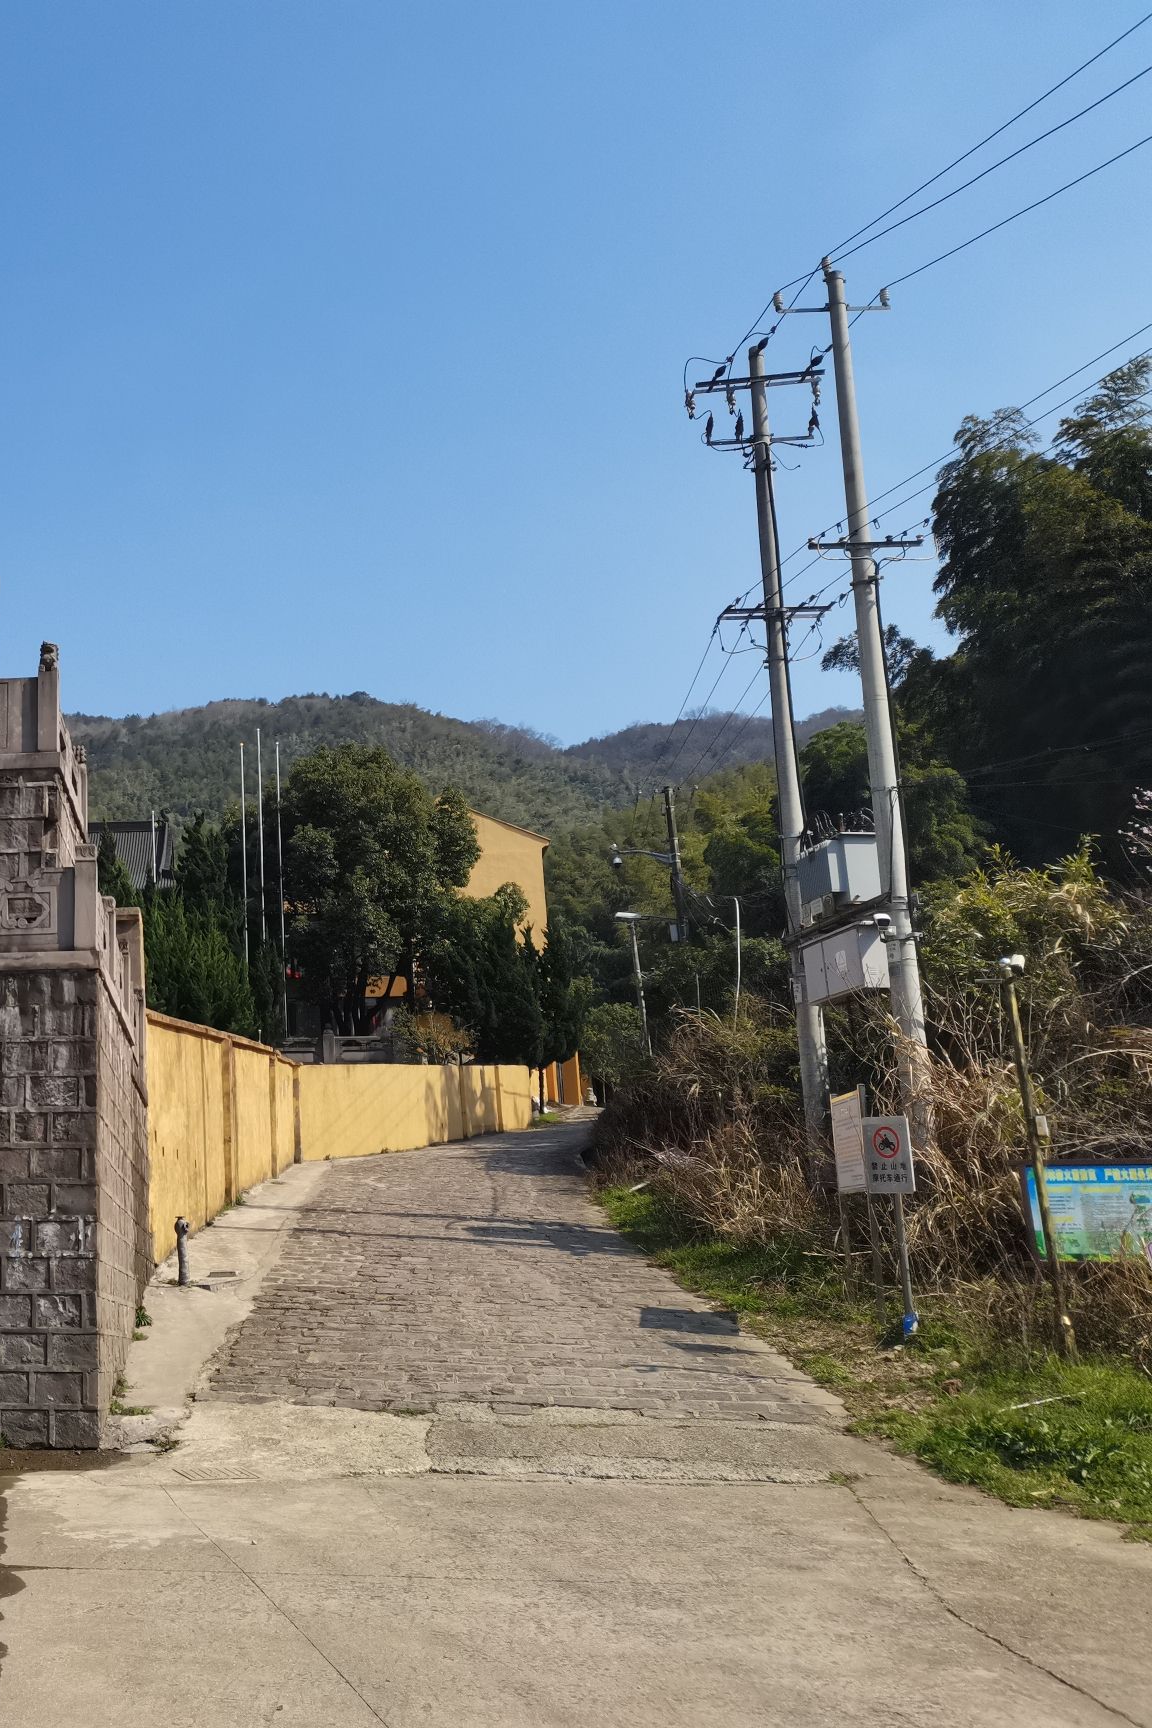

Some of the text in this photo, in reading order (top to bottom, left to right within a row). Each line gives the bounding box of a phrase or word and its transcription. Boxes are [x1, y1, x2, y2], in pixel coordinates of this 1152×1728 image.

[872, 1173, 908, 1183] 摩托车通行
